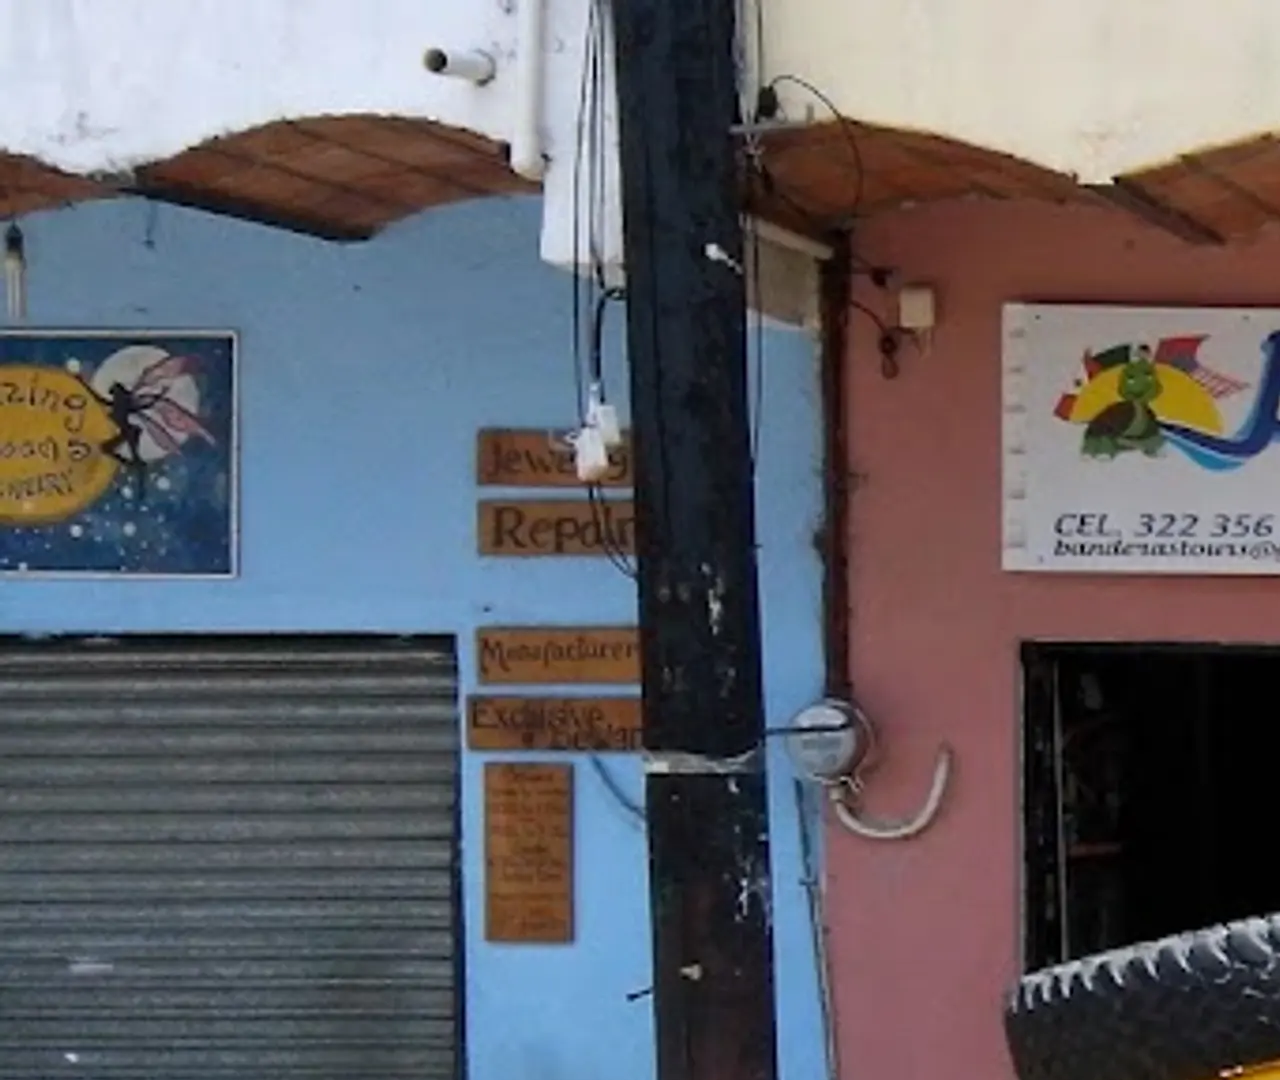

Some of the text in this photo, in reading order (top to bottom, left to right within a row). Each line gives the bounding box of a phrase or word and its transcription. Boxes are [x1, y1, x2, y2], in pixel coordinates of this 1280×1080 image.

[0, 380, 88, 433] zing
[1133, 513, 1199, 538] 322
[1210, 513, 1276, 538] 356
